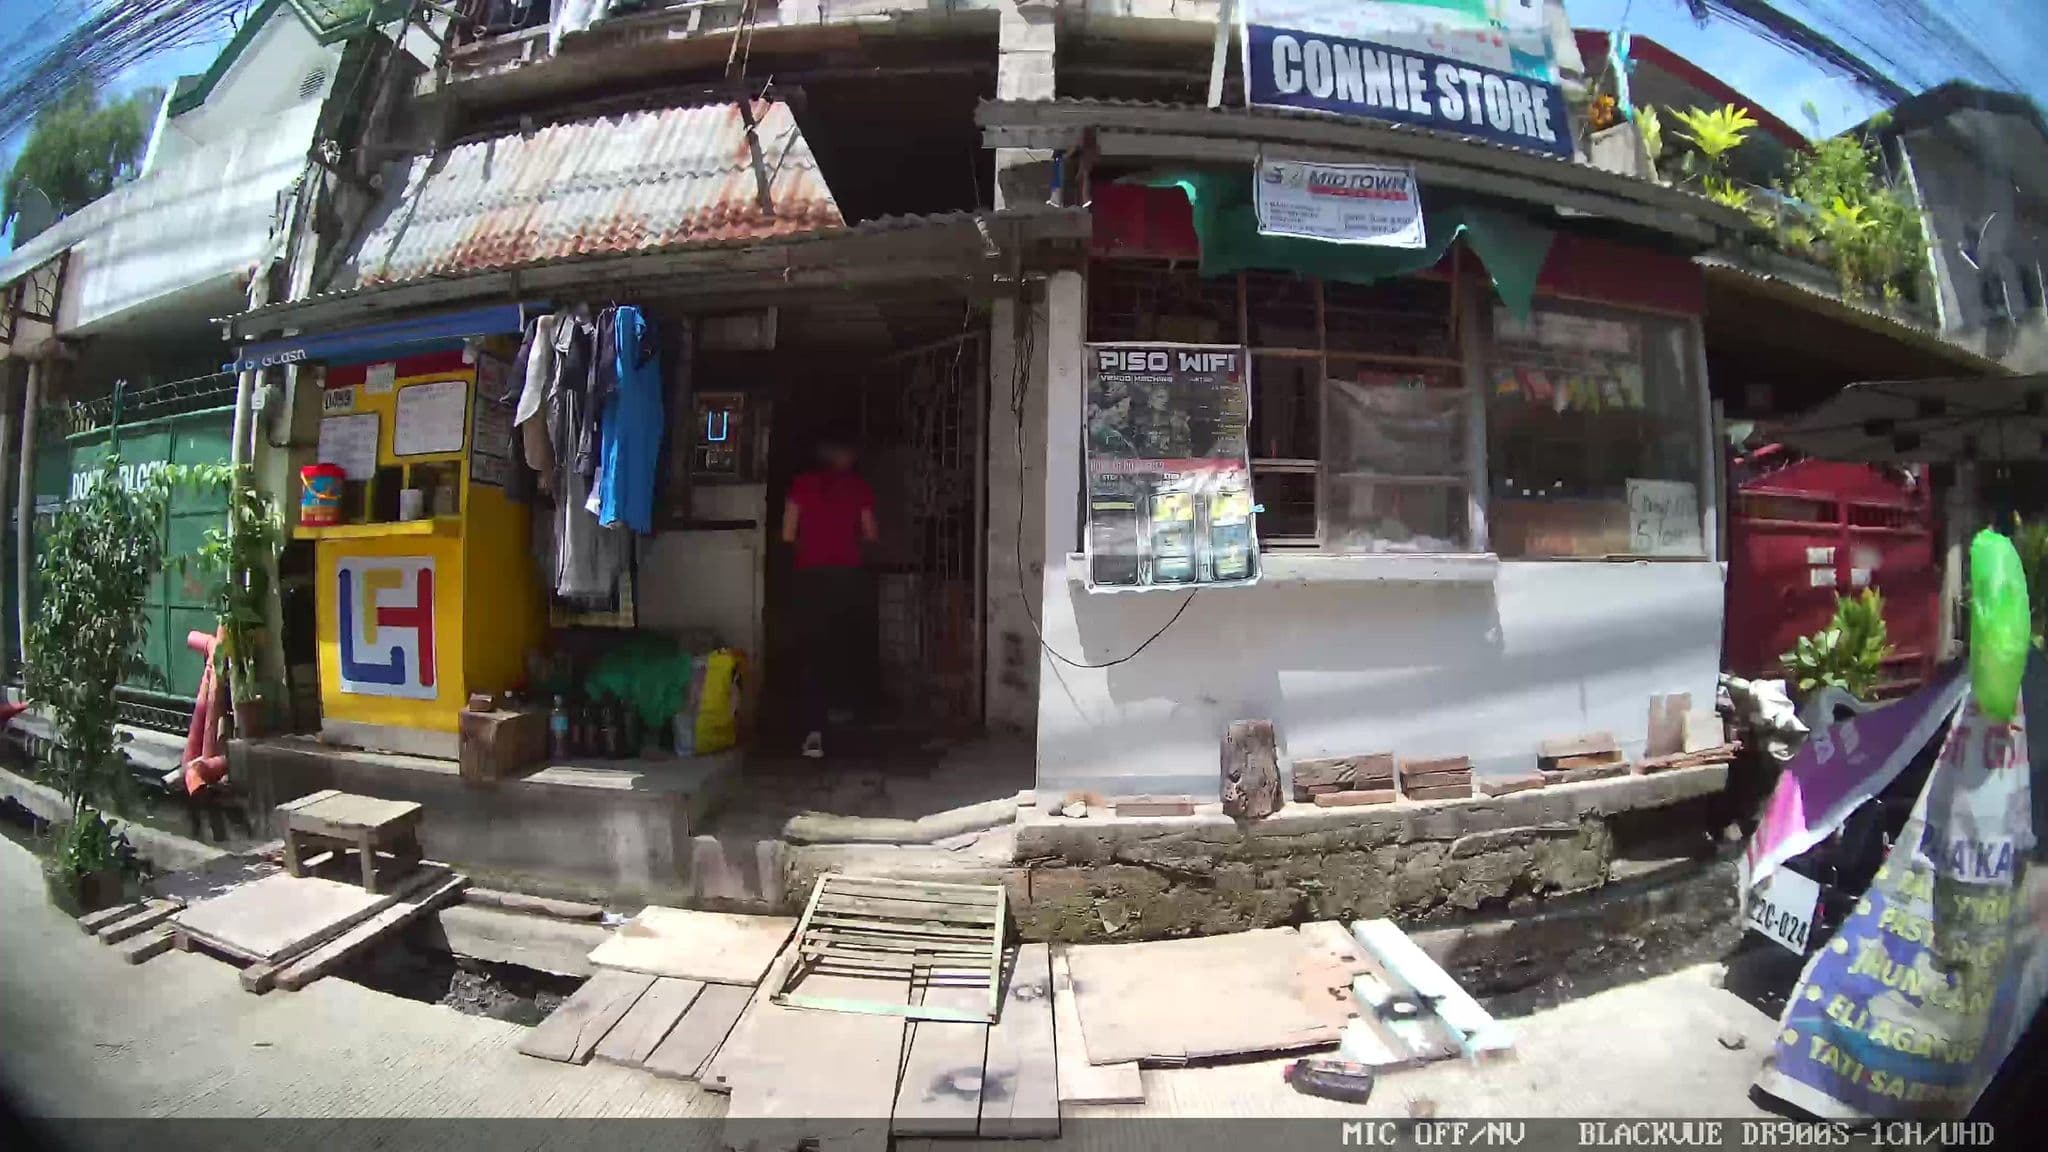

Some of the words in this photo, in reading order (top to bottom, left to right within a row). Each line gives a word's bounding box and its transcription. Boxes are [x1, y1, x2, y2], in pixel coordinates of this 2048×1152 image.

[1271, 34, 1432, 116] CONNIE
[1434, 62, 1556, 142] STORE
[1099, 351, 1169, 372] PISO
[1178, 352, 1235, 372] WIFI
